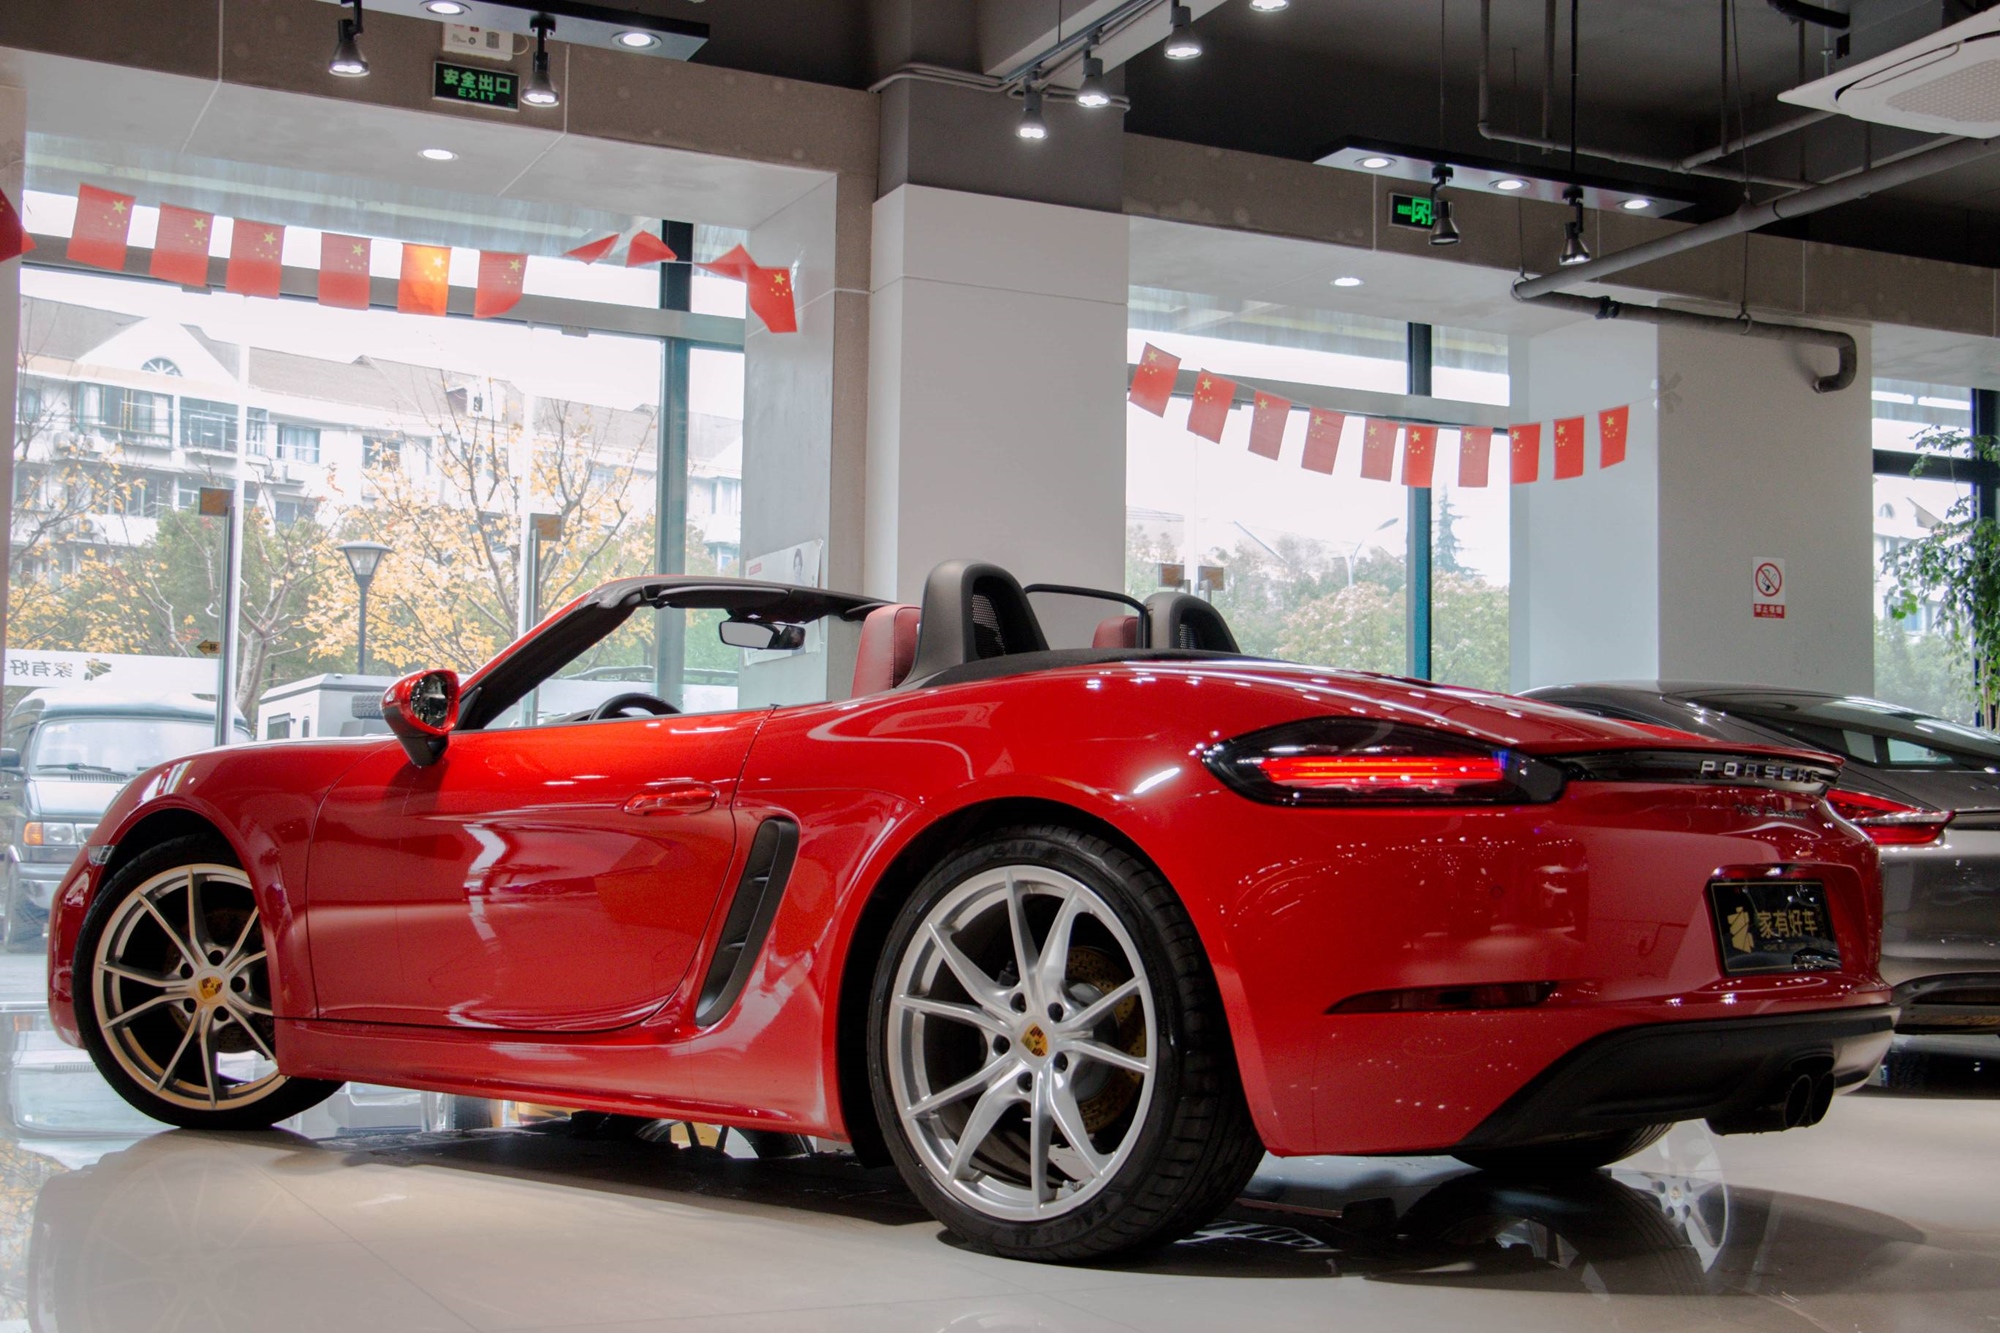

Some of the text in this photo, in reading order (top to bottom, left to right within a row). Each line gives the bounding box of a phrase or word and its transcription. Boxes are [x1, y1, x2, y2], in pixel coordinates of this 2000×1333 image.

[443, 69, 511, 94] 安全出口
[458, 87, 496, 101] EXIT
[1700, 760, 1821, 783] PORSCHE
[1757, 910, 1818, 938] 家有好车
